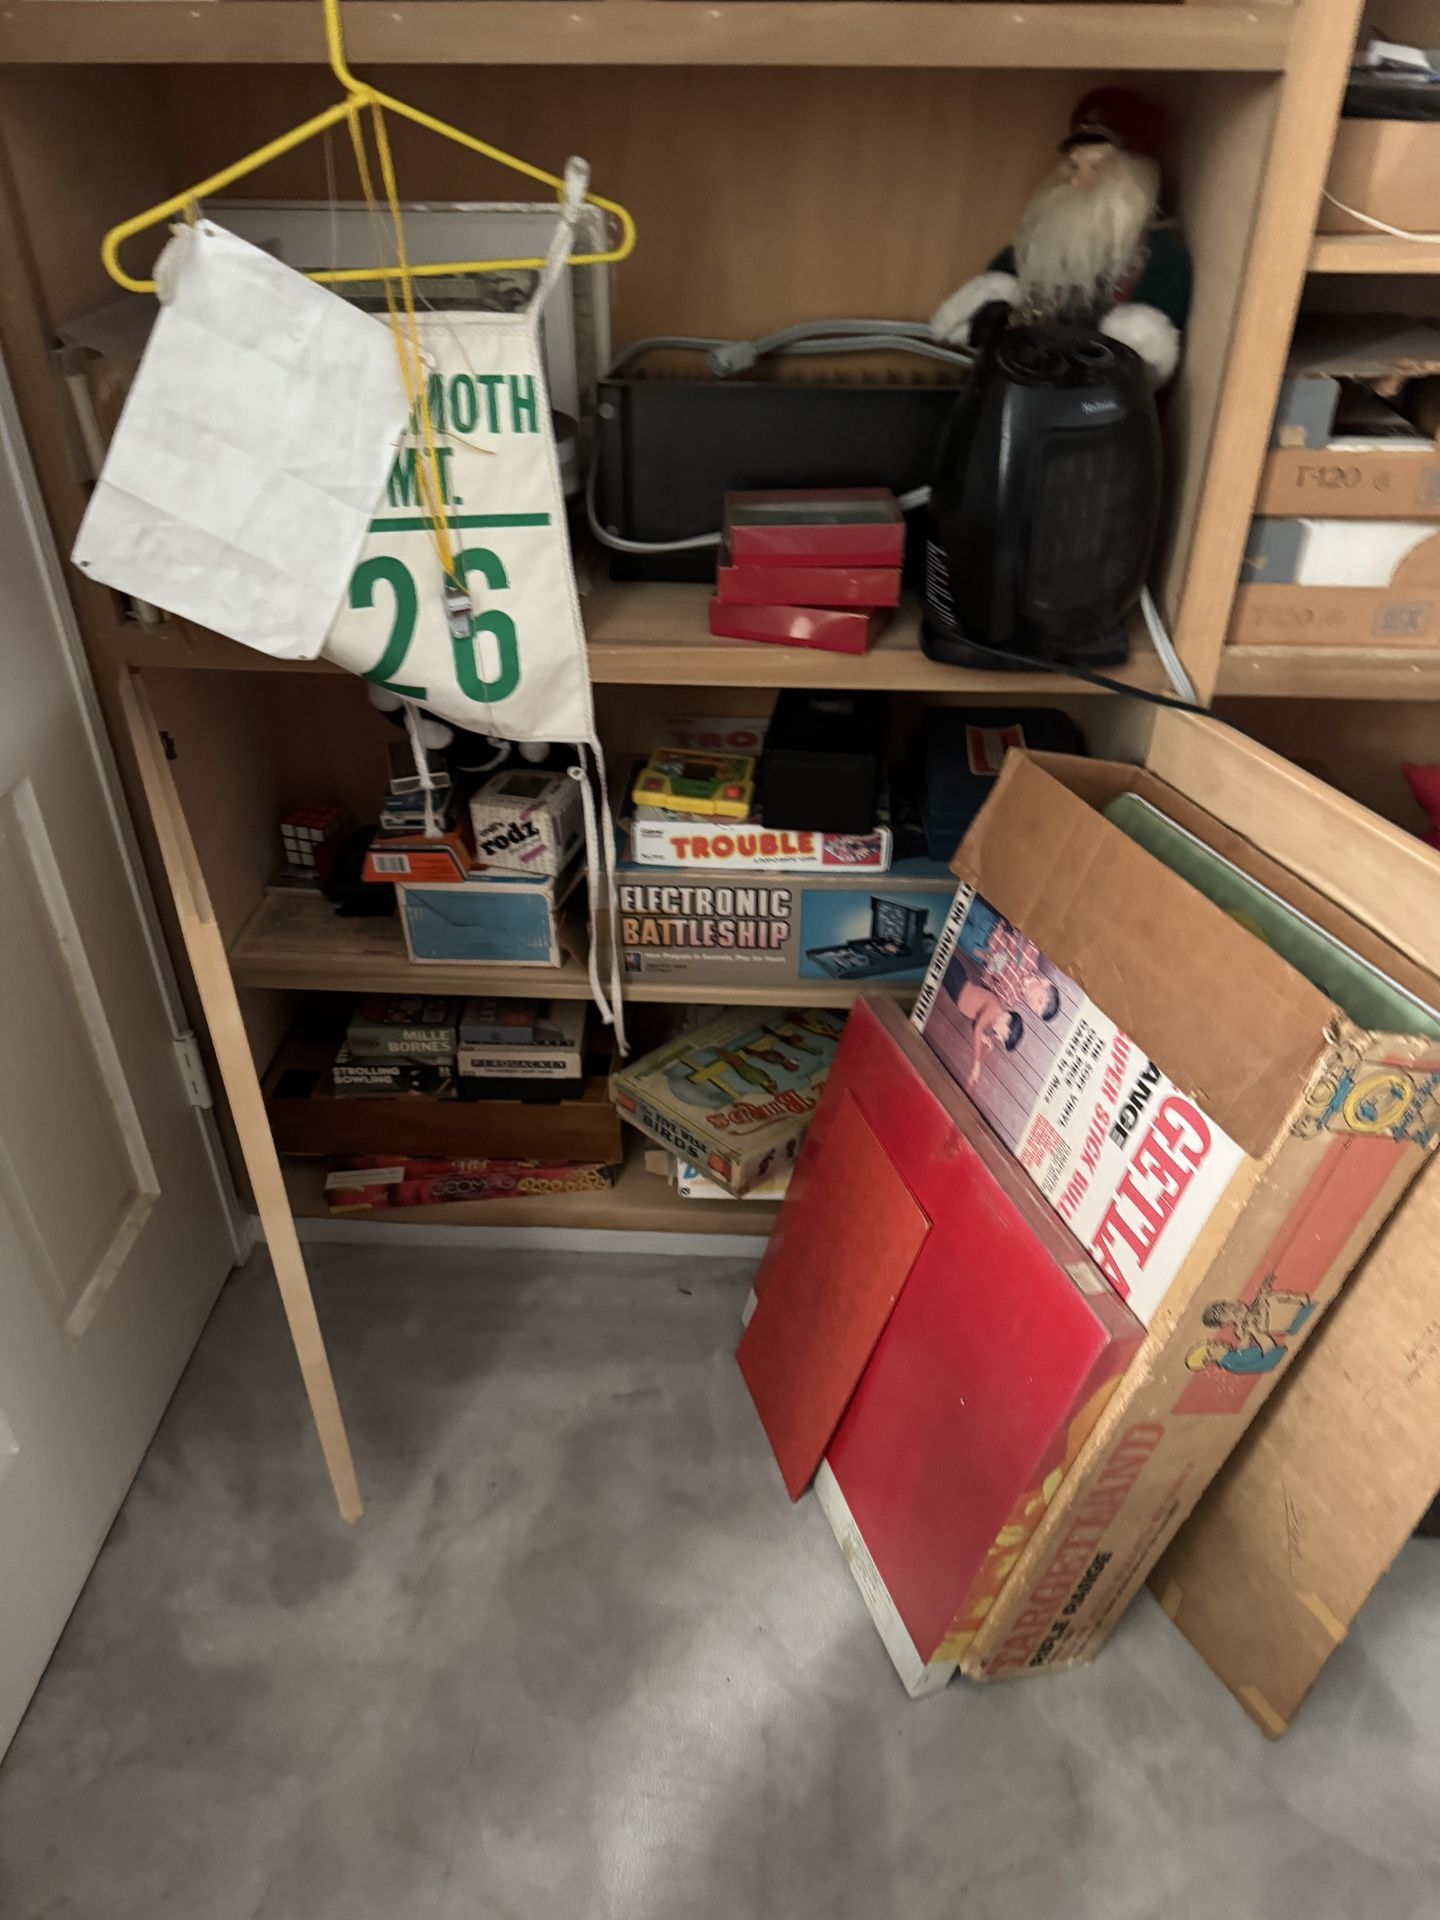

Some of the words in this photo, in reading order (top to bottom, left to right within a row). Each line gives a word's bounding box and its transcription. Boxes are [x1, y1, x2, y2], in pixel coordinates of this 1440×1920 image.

[349, 547, 521, 703] 26
[480, 821, 540, 856] rodz
[669, 831, 816, 860] TROUBLE
[618, 885, 792, 918] ELECTRONIC
[950, 900, 966, 924] ON
[620, 917, 792, 950] BATTLESHIP
[930, 926, 954, 981] TARGET
[914, 983, 934, 1021] WITH
[388, 1041, 451, 1052] BORNES
[403, 1030, 449, 1041] MILLE
[1064, 1018, 1088, 1057] DARTS
[1080, 1027, 1096, 1054] ONE
[1089, 1038, 1105, 1060] THE
[1063, 1055, 1082, 1087] PIECE
[1075, 1063, 1093, 1093] SOFT
[1057, 1094, 1078, 1128] VINYL
[644, 1115, 699, 1158] BIRDS
[1079, 1102, 1111, 1172] STICK
[1088, 1086, 1213, 1301] GETLA
